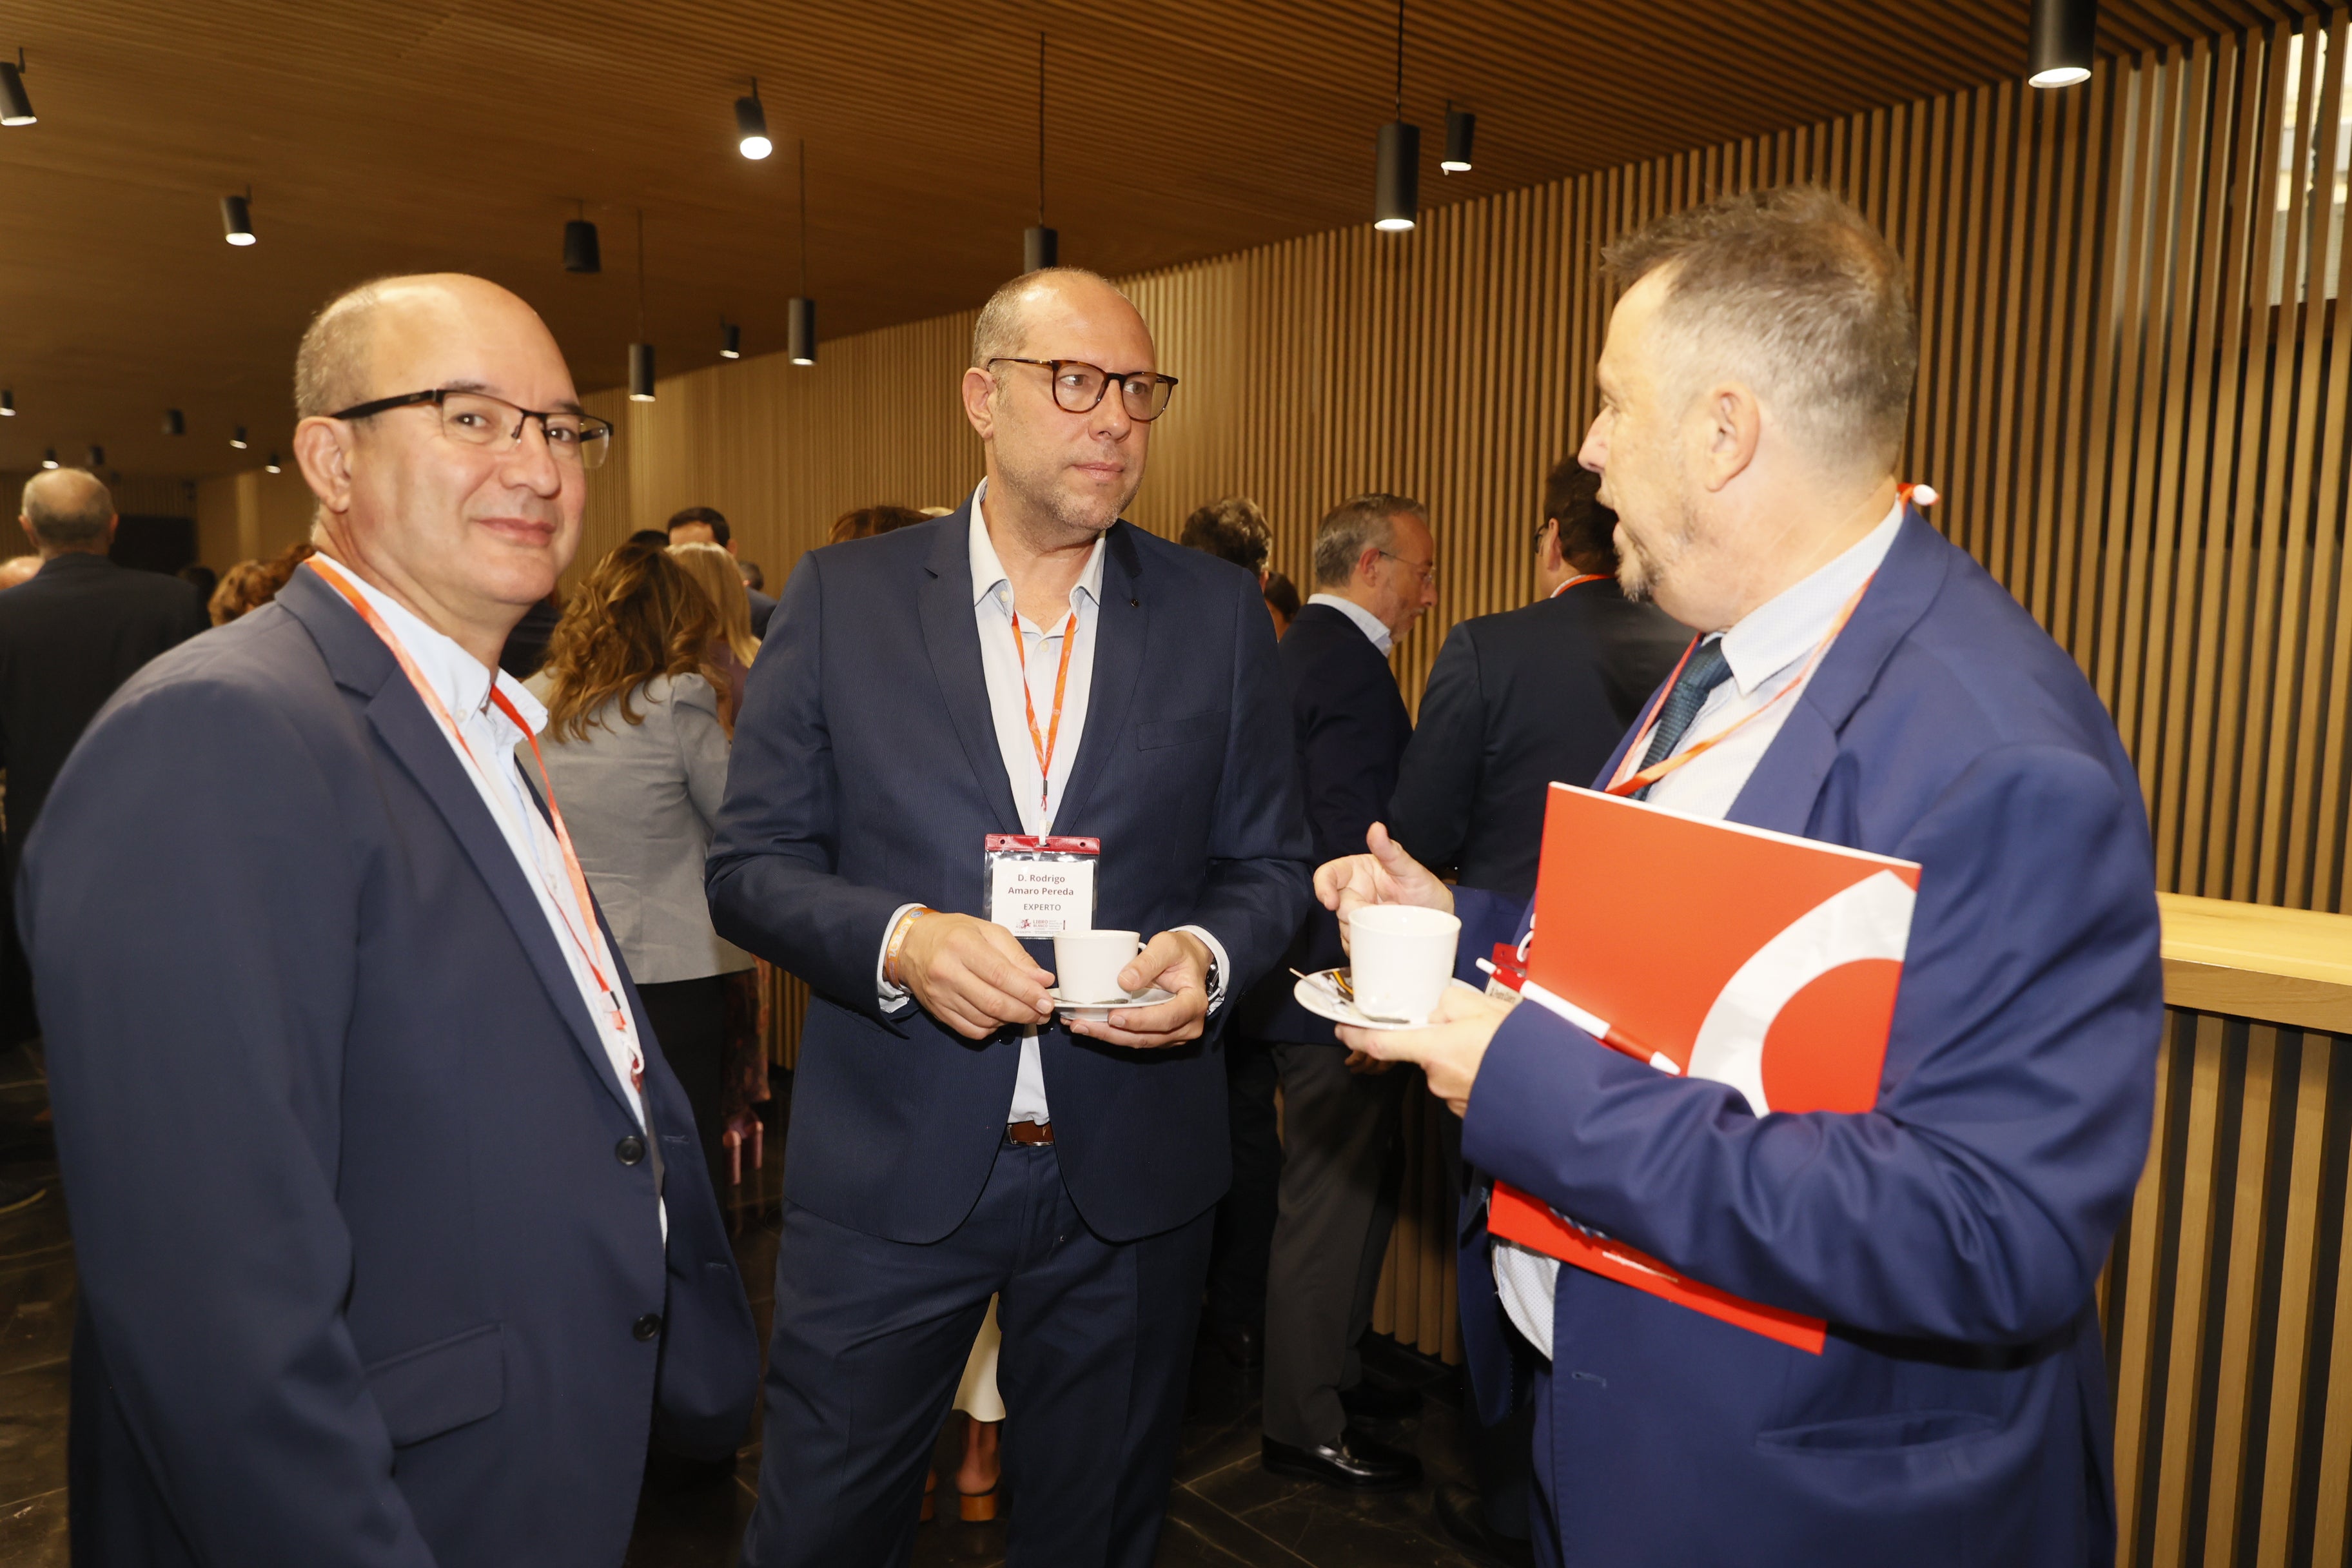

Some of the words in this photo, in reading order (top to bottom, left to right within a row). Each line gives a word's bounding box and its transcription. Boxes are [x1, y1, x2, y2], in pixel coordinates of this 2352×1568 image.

[1018, 874, 1027, 882] D.
[1030, 874, 1065, 885] Rodrigo
[1008, 887, 1039, 895] Amaro
[1042, 887, 1073, 896] Pereda
[888, 917, 914, 959] ASPECYL
